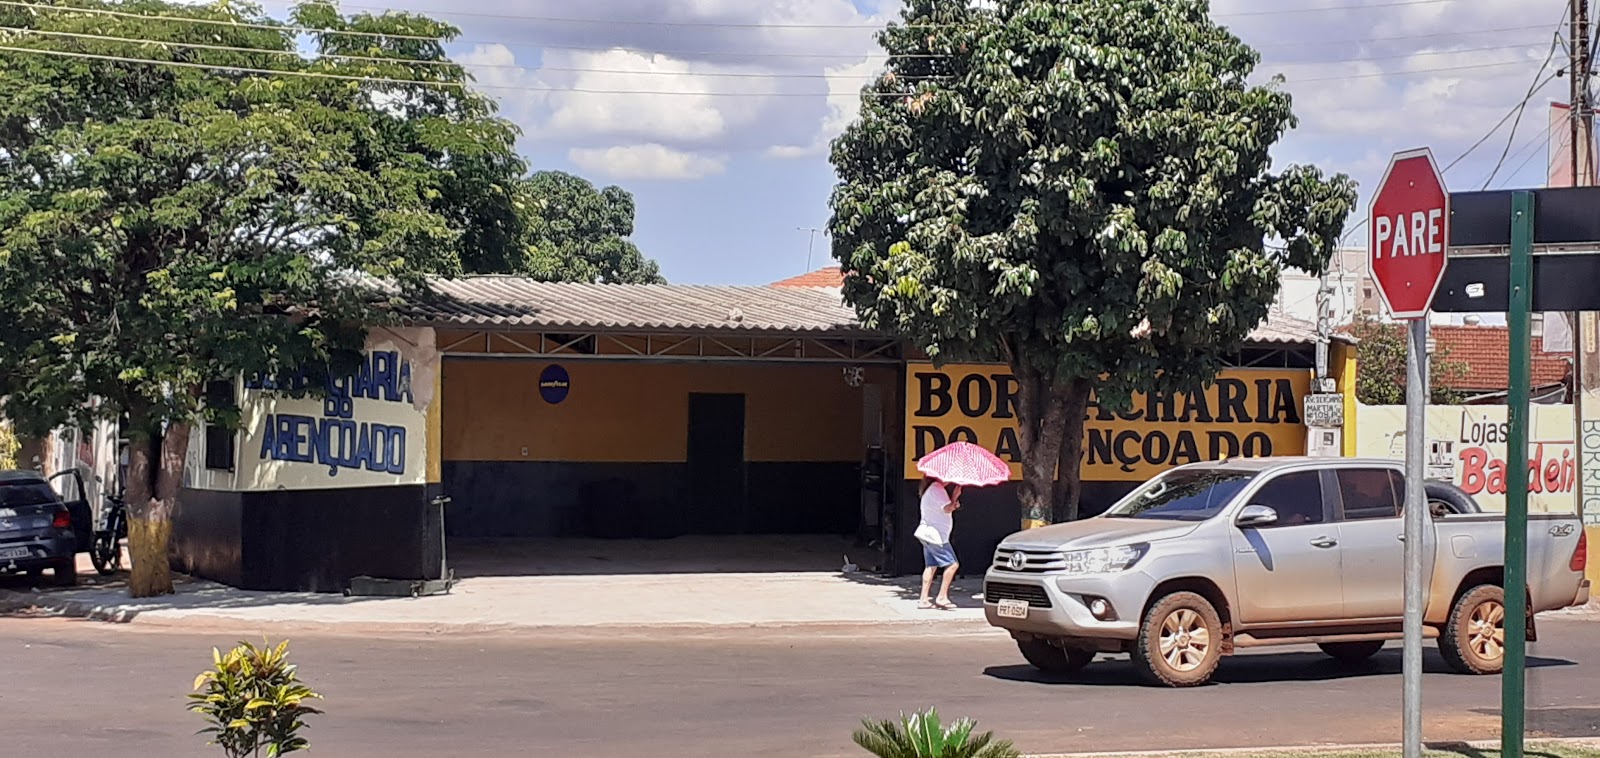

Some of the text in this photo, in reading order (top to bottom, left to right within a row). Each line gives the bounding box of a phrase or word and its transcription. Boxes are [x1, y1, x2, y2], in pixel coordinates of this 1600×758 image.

[1376, 208, 1442, 259] PARE
[324, 396, 354, 418] DO
[1460, 411, 1509, 446] Lojas
[260, 414, 406, 477] ABENÇOADO
[1459, 442, 1574, 494] Badeir
